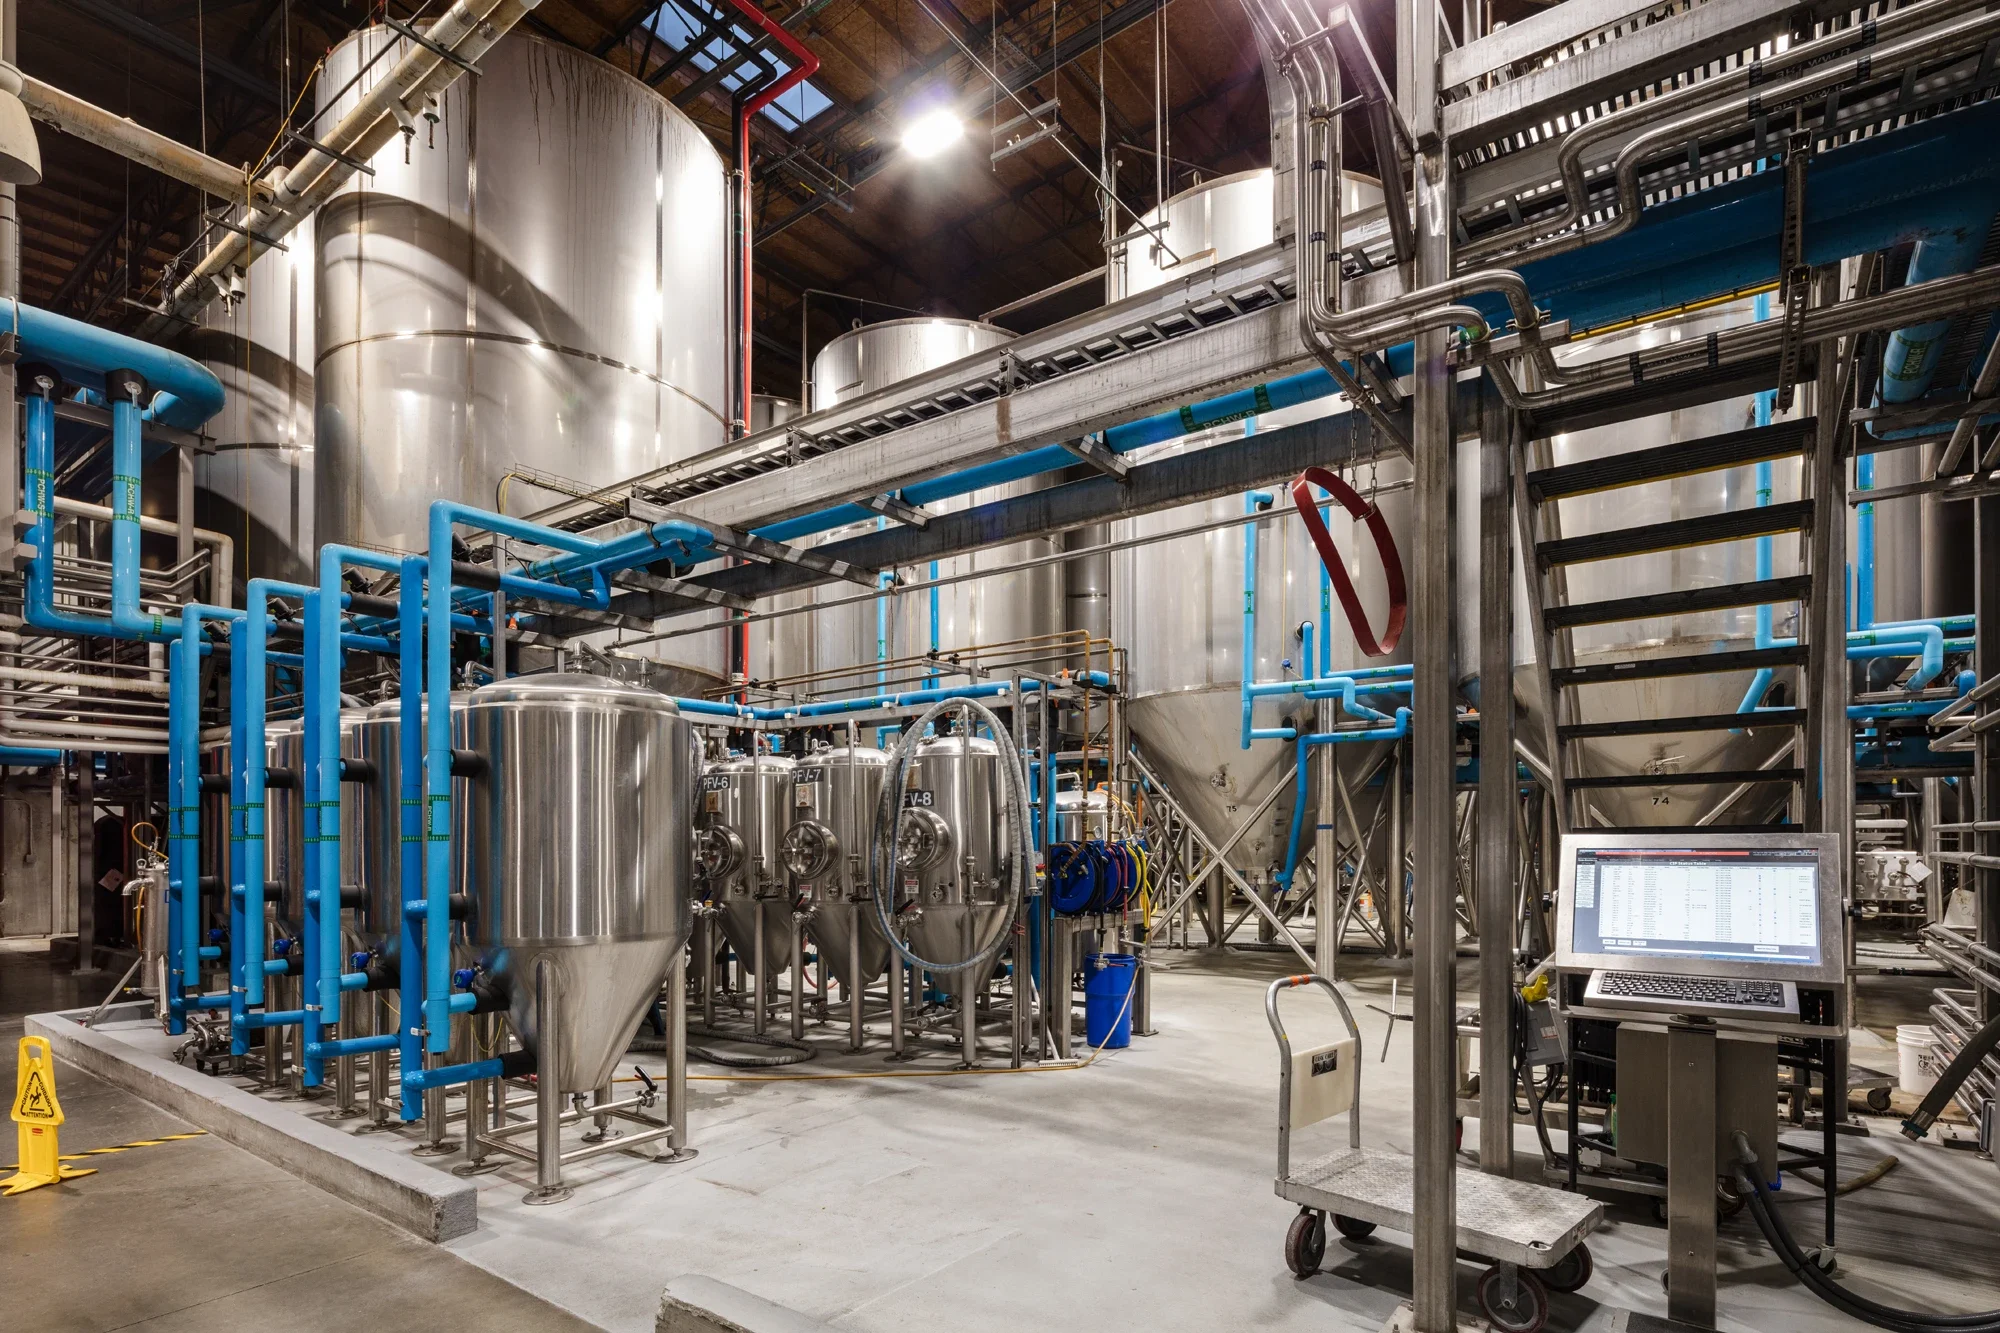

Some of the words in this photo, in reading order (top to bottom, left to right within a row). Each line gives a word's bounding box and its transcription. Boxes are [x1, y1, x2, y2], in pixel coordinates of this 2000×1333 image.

[1203, 409, 1256, 430] PCHW-R
[37, 478, 46, 512] PCHW-S
[127, 483, 136, 515] PCHW-R
[703, 776, 728, 789] PFV-6
[792, 768, 822, 783] PFV-7
[904, 792, 932, 806] FV-8
[1652, 796, 1670, 806] 74
[1226, 805, 1238, 813] 75
[21, 1080, 33, 1106] CAUTION
[38, 1081, 52, 1107] CUIDADO
